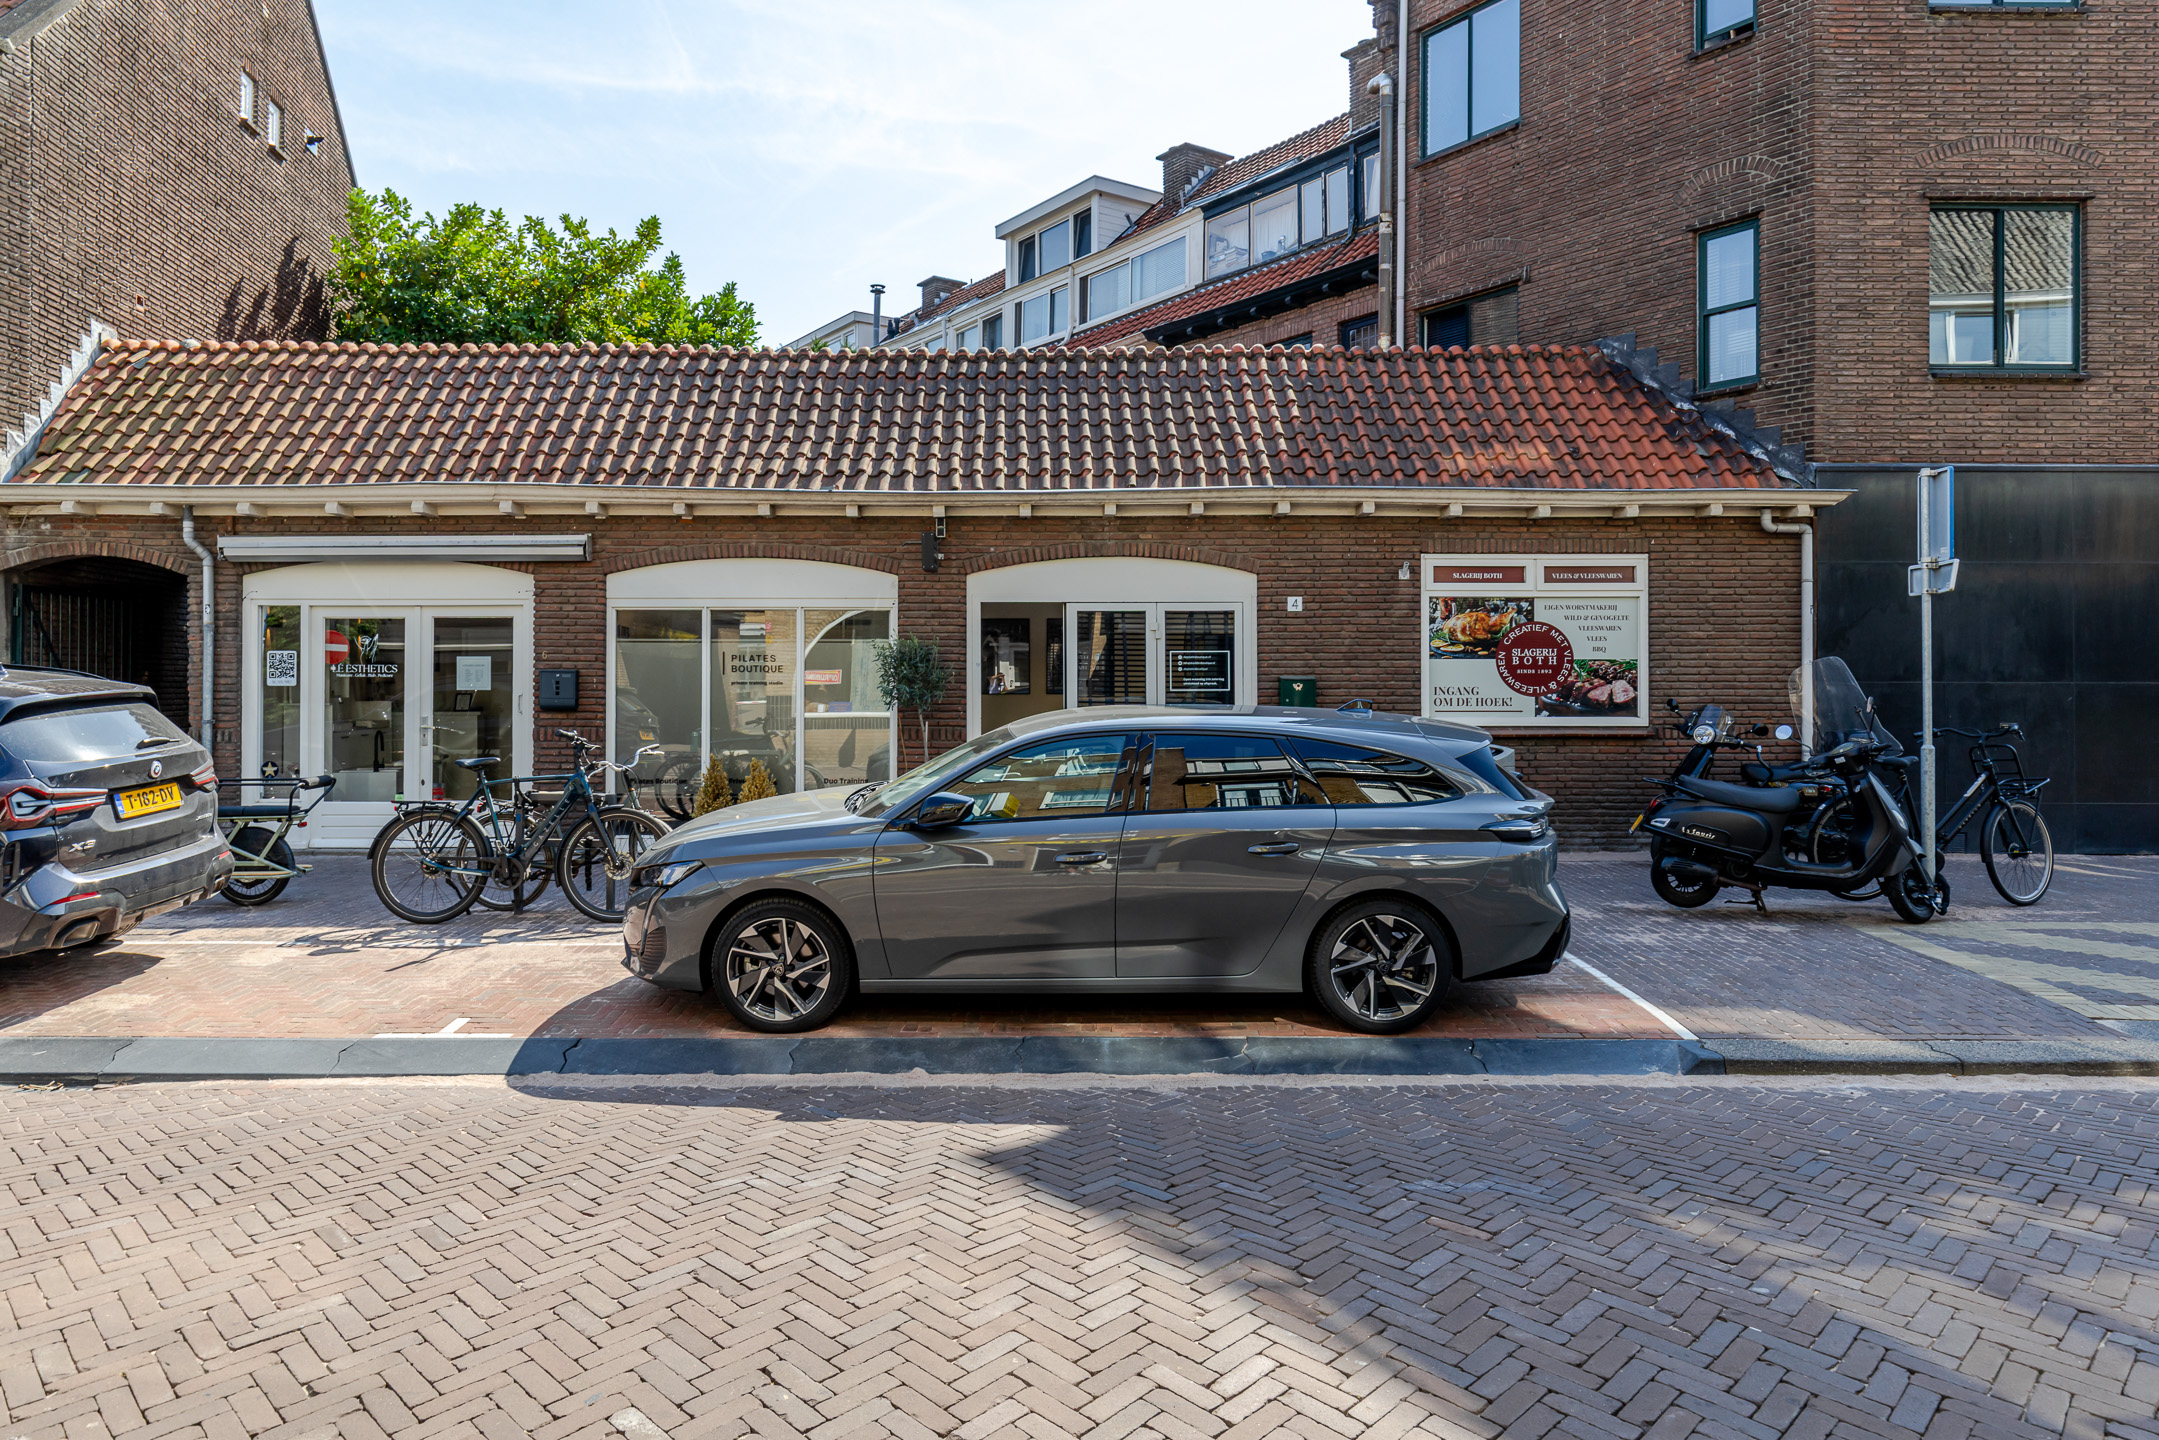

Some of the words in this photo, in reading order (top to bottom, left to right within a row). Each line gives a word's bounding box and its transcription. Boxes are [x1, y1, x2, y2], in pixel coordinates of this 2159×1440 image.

[1452, 572, 1482, 580] SLAGERIJ
[1291, 598, 1299, 610] 4
[1503, 624, 1549, 645] CREATIEF
[1550, 629, 1569, 647] MET
[541, 651, 548, 660] 6
[1512, 648, 1557, 656] SLAGERIJ
[731, 654, 777, 662] PILATES
[1512, 656, 1557, 665] BOTH
[346, 664, 398, 673] ESTHETICS
[731, 664, 784, 673] BOUTIQUE
[1557, 649, 1571, 682] VLEES
[1498, 651, 1547, 693] VLEESWAREN
[1548, 681, 1558, 690] &
[1434, 687, 1479, 695] INGANG
[1433, 698, 1453, 706] OM
[1456, 698, 1473, 706] DE
[1475, 697, 1513, 706] HOEK!
[126, 786, 174, 809] T-182-DV
[533, 799, 570, 847] GAZELLE
[68, 839, 97, 853] X3
